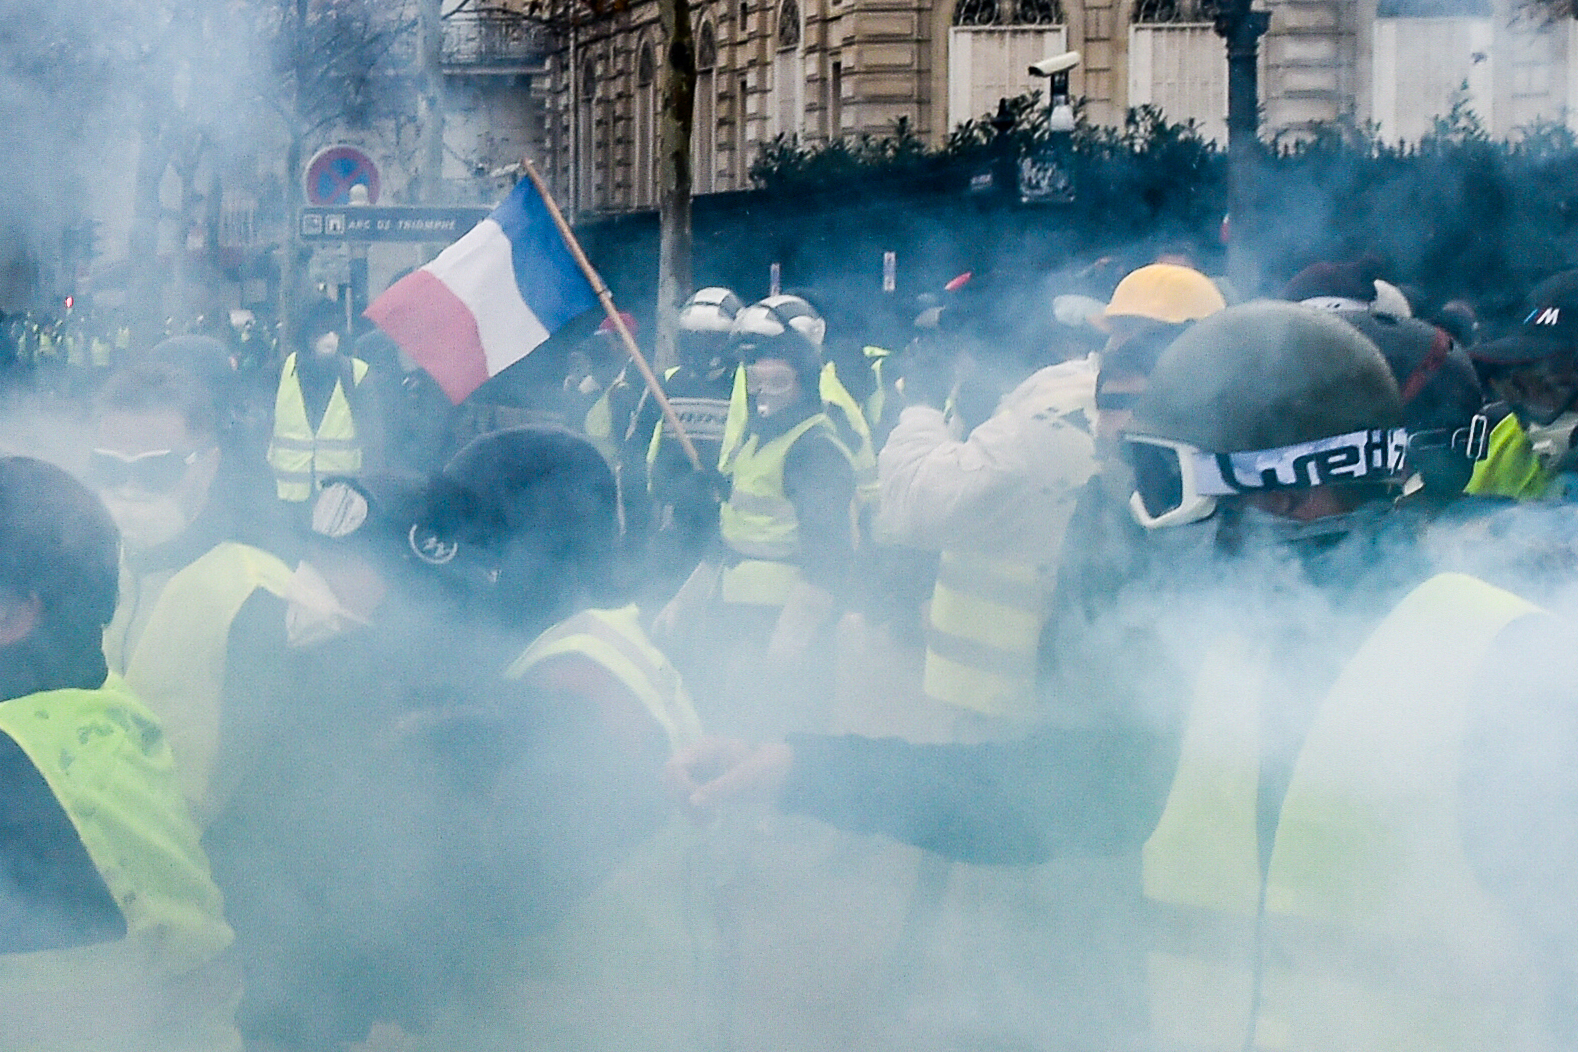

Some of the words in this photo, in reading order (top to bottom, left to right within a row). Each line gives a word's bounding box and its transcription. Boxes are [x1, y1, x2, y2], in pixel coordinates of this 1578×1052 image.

[347, 219, 371, 230] ARC
[376, 219, 391, 230] DE
[397, 219, 456, 231] TRIOMPHE
[1535, 307, 1560, 326] M
